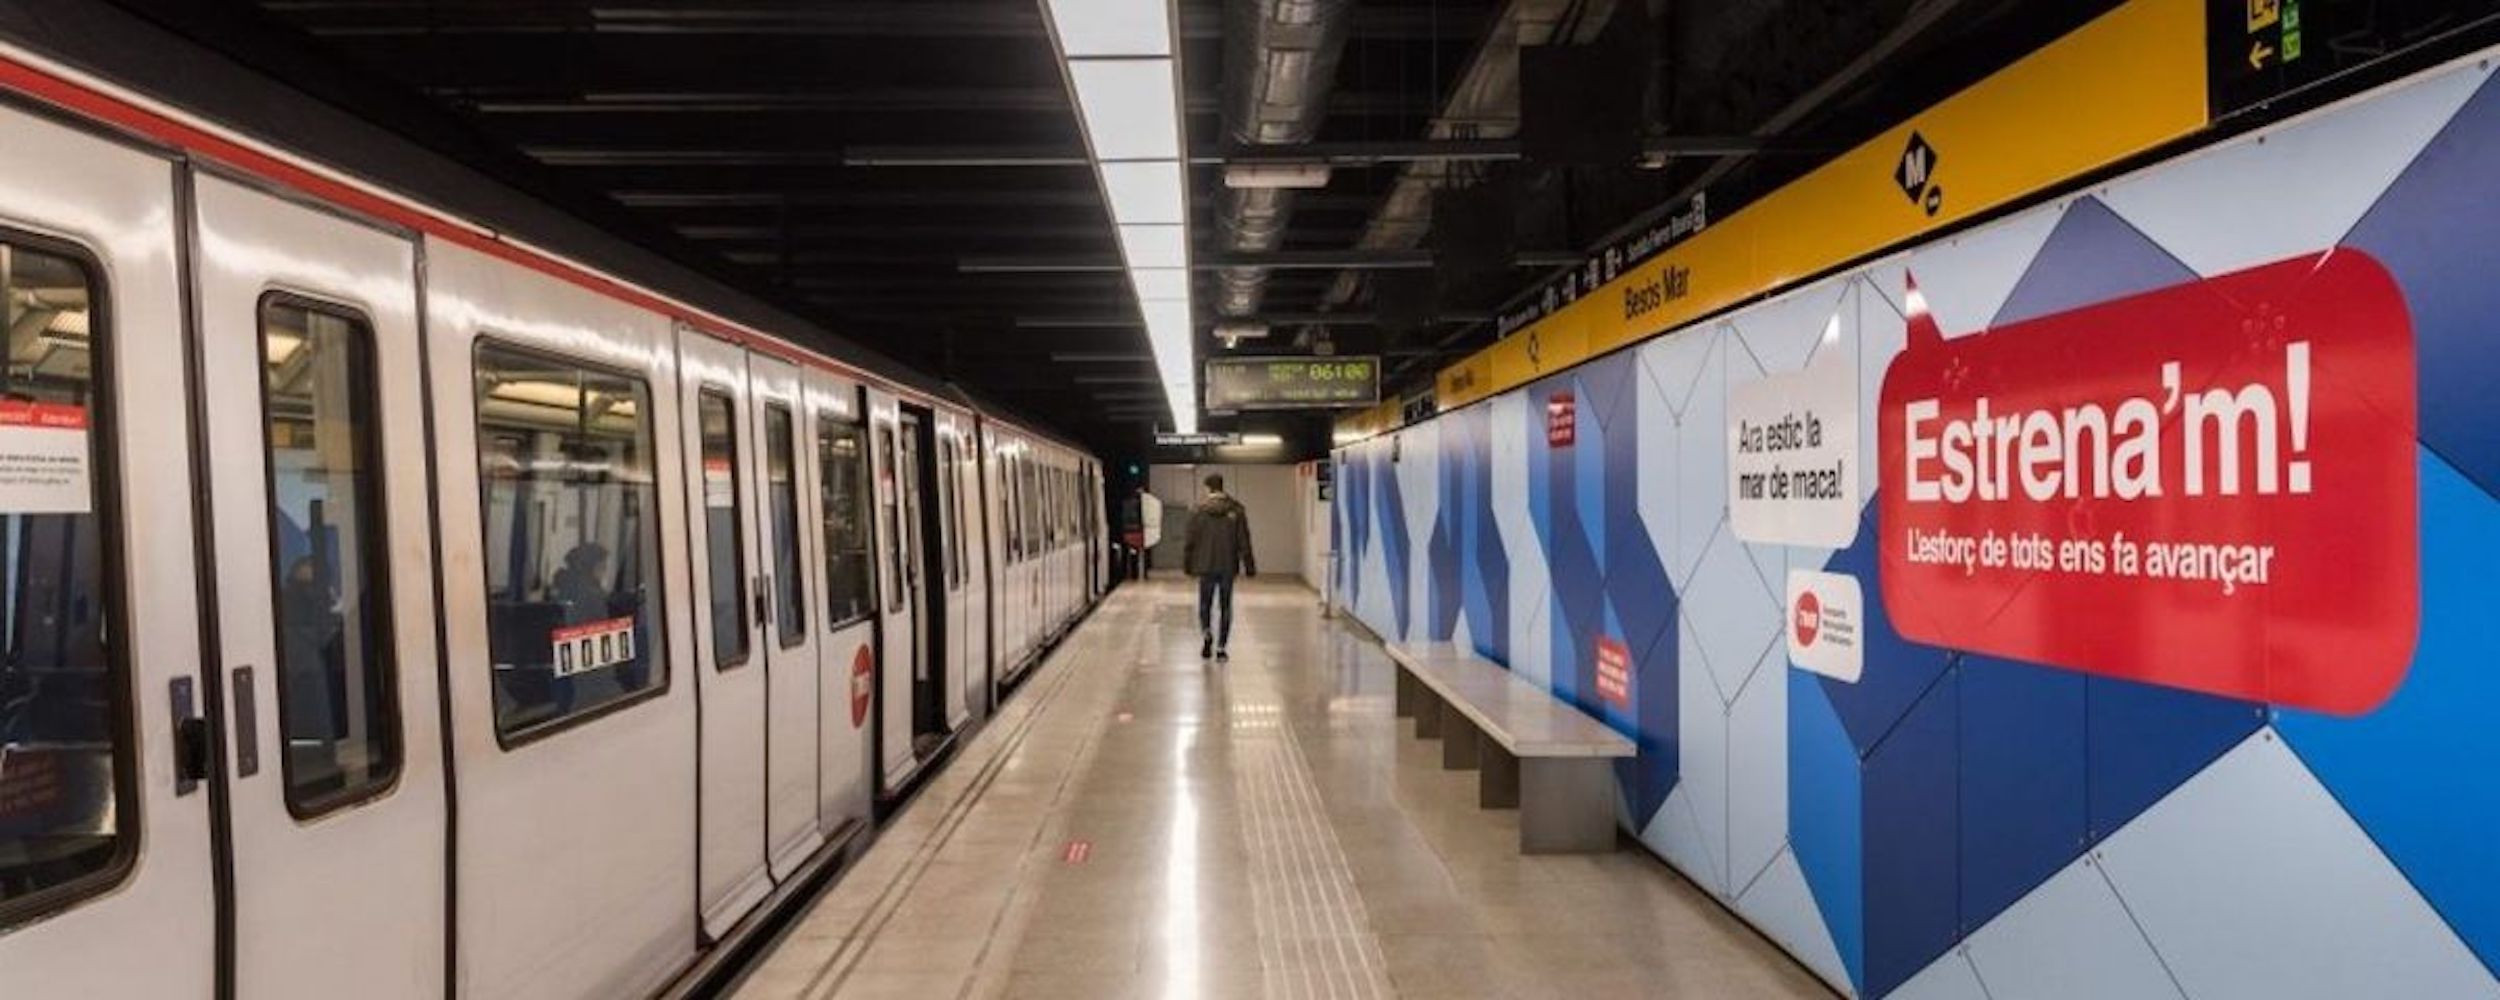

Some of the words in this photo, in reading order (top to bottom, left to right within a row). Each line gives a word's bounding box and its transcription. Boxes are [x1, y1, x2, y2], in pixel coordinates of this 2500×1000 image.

[1905, 145, 1926, 189] M
[1664, 266, 1689, 302] Mar
[1739, 419, 1763, 453] Ara
[1767, 412, 1802, 451] estic
[1806, 410, 1821, 447] la
[1905, 340, 2312, 503] Estrena'm!
[1740, 472, 1764, 499] mar
[1769, 464, 1788, 499] de
[1792, 459, 1842, 499] maca!
[1908, 528, 1976, 576] L'esforç
[1980, 529, 2007, 568] de
[2010, 532, 2054, 570] tots
[2060, 538, 2106, 574] ens
[2112, 531, 2139, 576] fa
[2146, 542, 2274, 596] avançar
